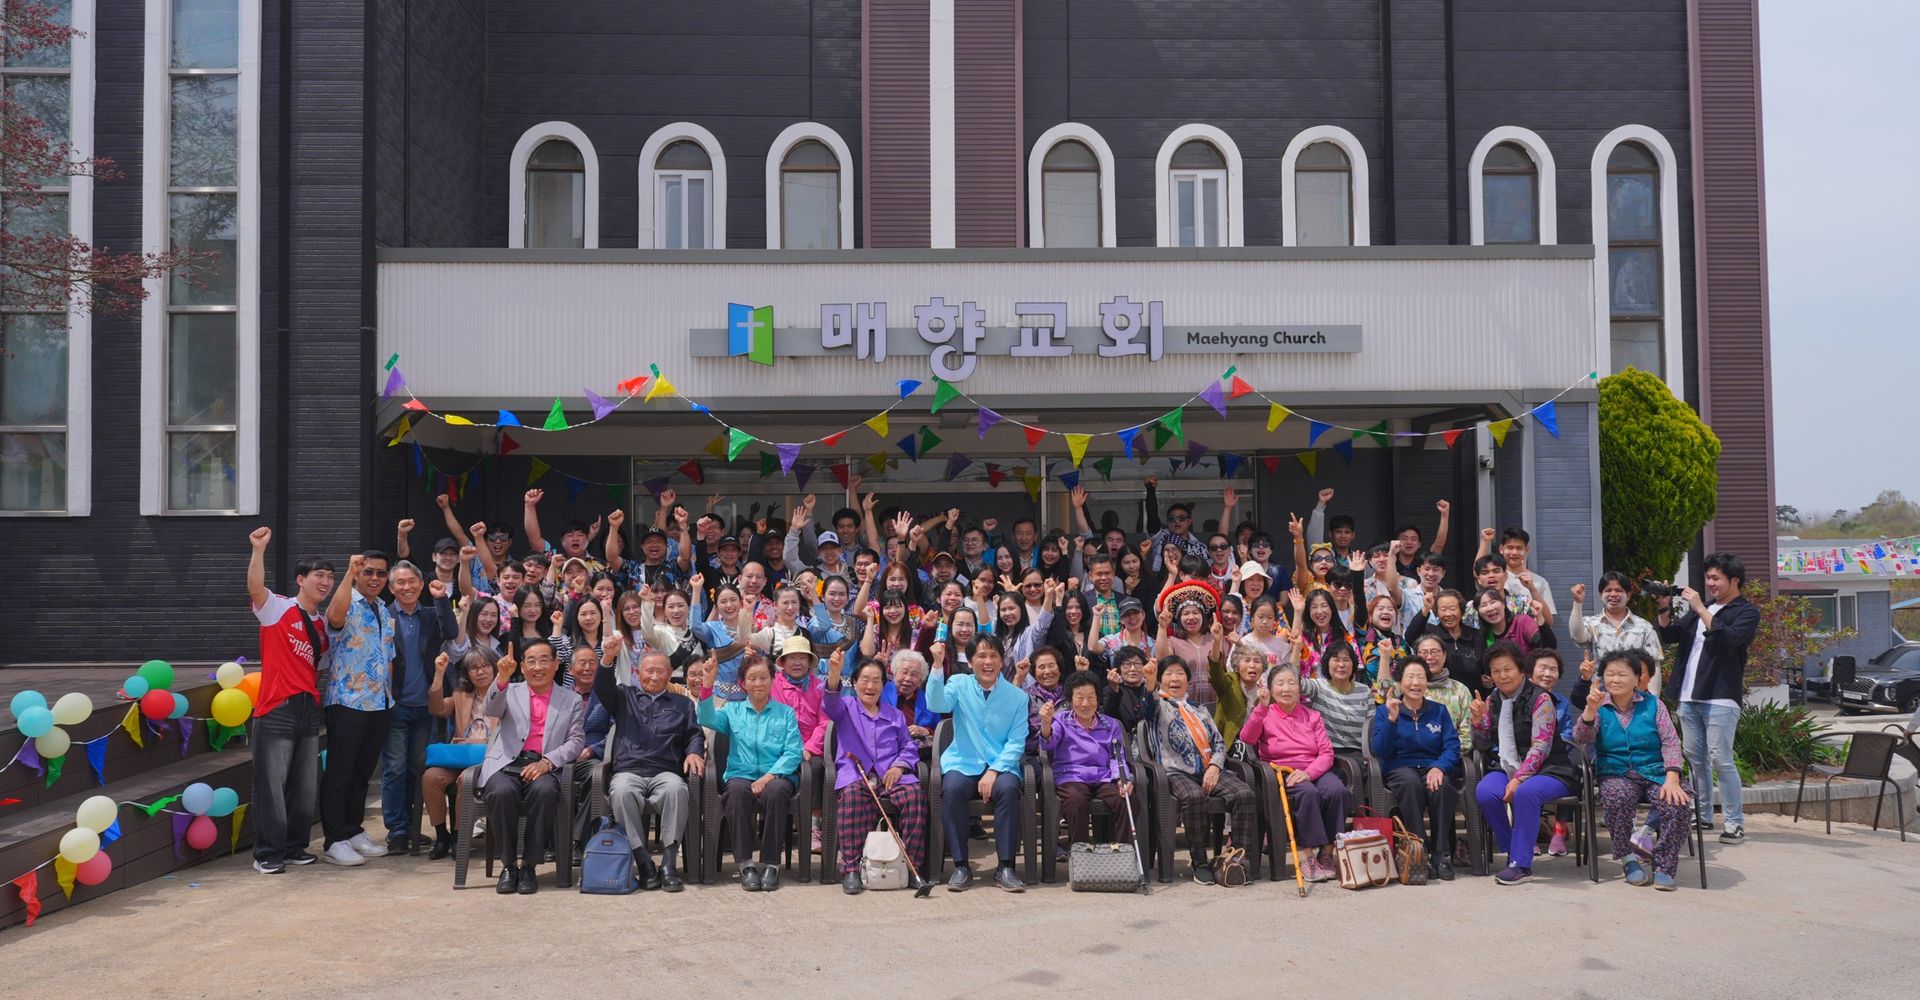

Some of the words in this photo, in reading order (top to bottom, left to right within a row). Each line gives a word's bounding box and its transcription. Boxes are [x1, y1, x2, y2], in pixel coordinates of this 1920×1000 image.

[820, 296, 1164, 382] 매향교회
[1187, 332, 1268, 347] Maehyang
[1273, 331, 1326, 344] Church
